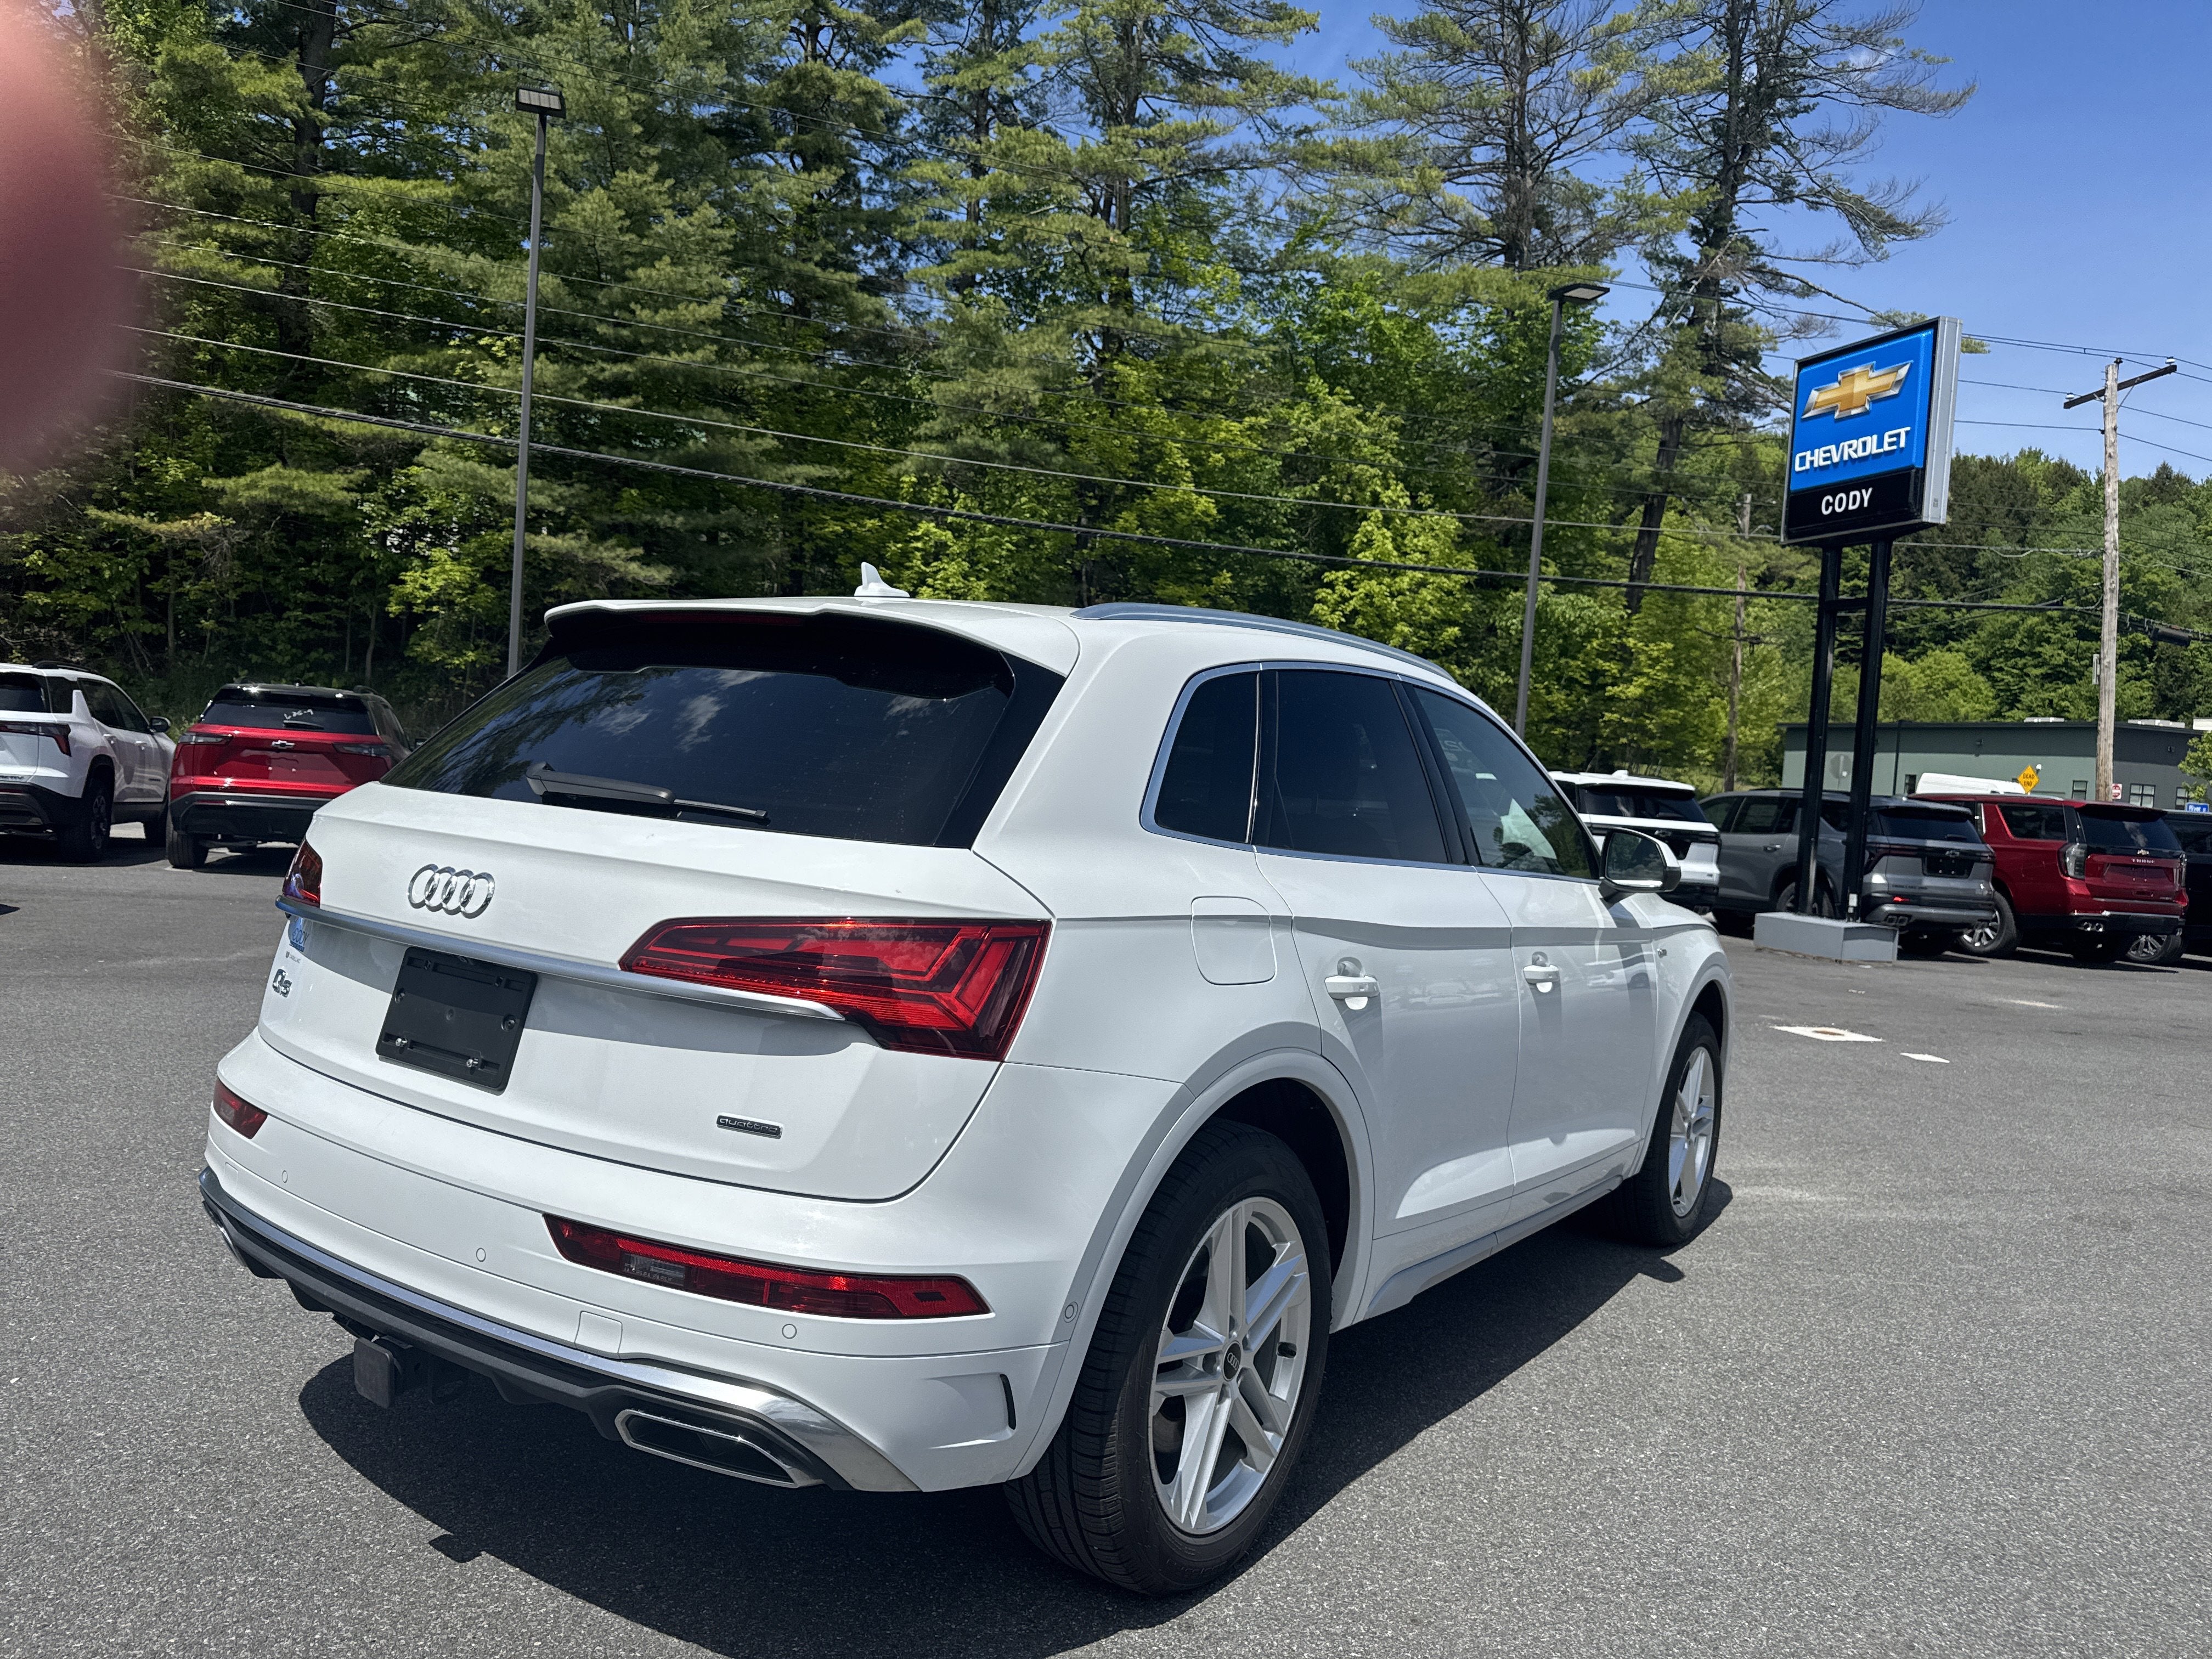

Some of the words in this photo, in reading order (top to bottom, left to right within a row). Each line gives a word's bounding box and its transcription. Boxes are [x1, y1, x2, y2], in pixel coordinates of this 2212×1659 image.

[1795, 426, 1911, 472] CHEVROLET
[1821, 487, 1873, 516] CODY
[292, 928, 309, 945] CODY
[272, 968, 292, 998] Q5
[719, 1118, 778, 1133] quattro
